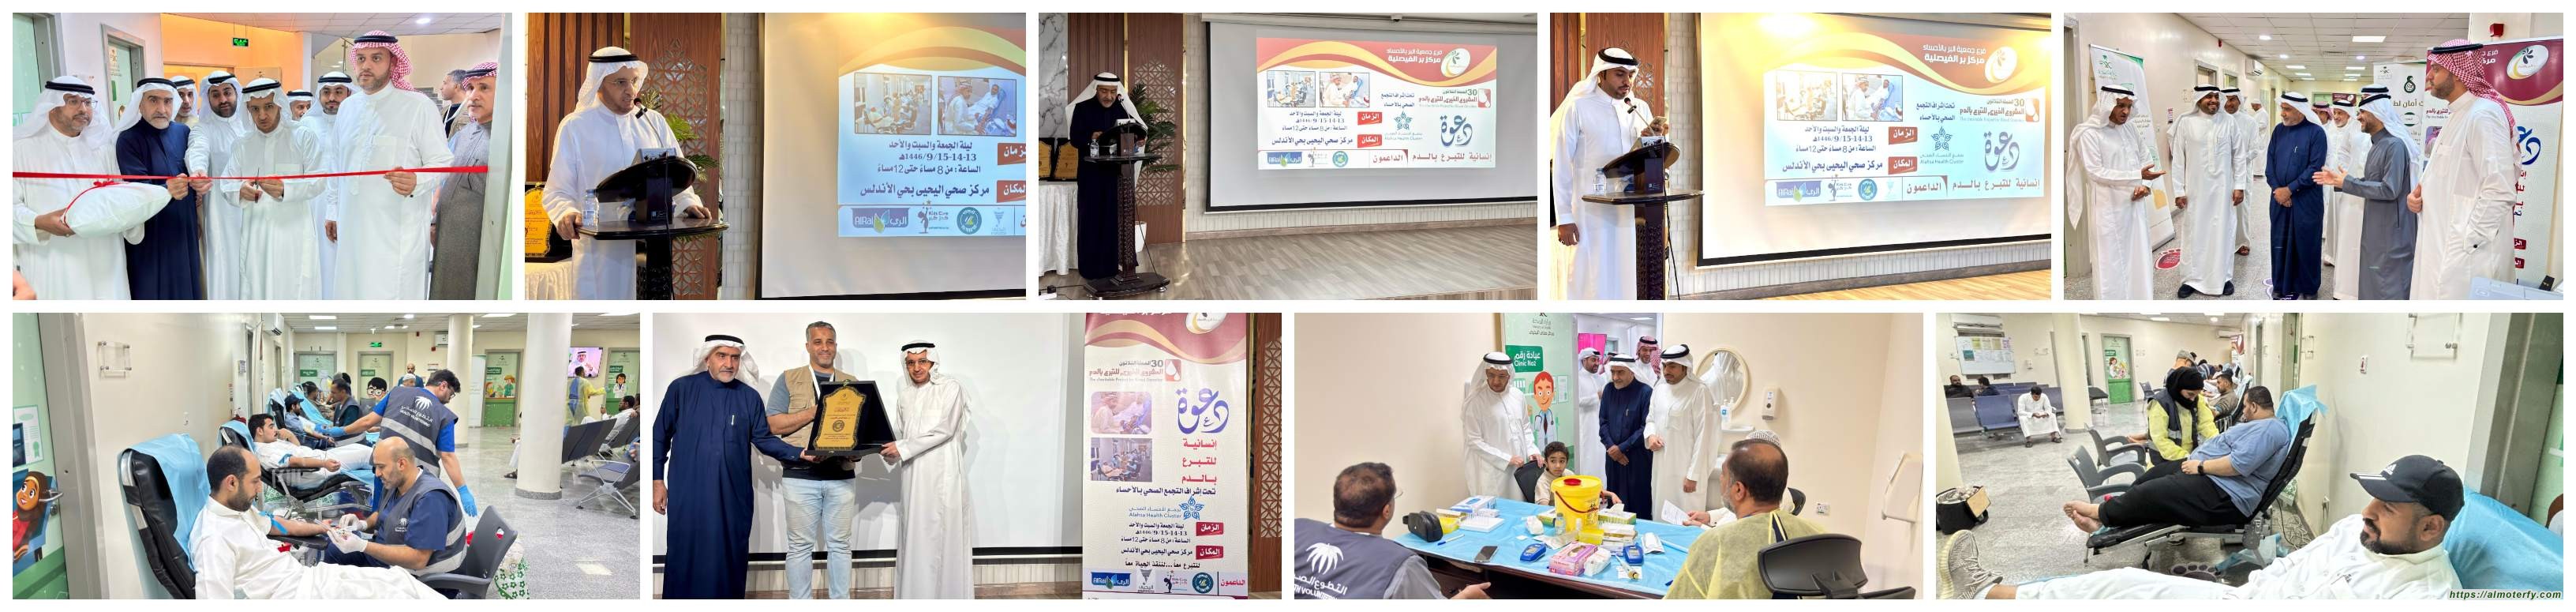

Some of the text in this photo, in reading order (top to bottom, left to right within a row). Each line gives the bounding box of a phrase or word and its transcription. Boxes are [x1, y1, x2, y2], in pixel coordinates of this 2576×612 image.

[1956, 46, 1976, 54] جمعية
[1924, 53, 1985, 65] مركز بر الفيصلية
[1893, 129, 1915, 138] الزمان
[889, 139, 911, 150] والأحد
[912, 140, 935, 150] والسبت
[937, 141, 958, 151] الجمعة
[1983, 131, 2020, 171] دعوة
[1372, 154, 1403, 163] الداعمون
[1441, 152, 1465, 162] للتبرع
[1469, 152, 1492, 163] إنسانية
[1782, 160, 1810, 172] الأندلس
[1811, 163, 1825, 172] بحي
[1849, 161, 1866, 172] صحي
[1866, 160, 1882, 170] مركز
[1893, 158, 1914, 169] المكان
[894, 165, 904, 174] 12
[904, 165, 918, 175] حتى
[937, 165, 943, 175] 8
[945, 167, 953, 175] من
[1906, 182, 1941, 194] الداعمون
[1985, 178, 2011, 190] للتبرع
[2016, 177, 2040, 190] إنسانية
[860, 183, 990, 197] مركز صحي اليحيى بحي الأندلس
[1003, 183, 1026, 195] لمكان
[1515, 351, 1541, 361] عيادة رقم
[1151, 359, 1163, 368] 30
[1104, 368, 1119, 377] للتبرع
[1175, 388, 1229, 434] دعوة
[1183, 438, 1217, 450] إنسانية
[1144, 487, 1163, 497] الصحي
[1163, 486, 1184, 496] التجمع
[1184, 487, 1202, 496] إشراف
[1200, 524, 1219, 532] الزمان
[1200, 547, 1219, 557] المكان
[1220, 578, 1245, 587] الداعمون
[1313, 580, 1348, 595] التطوع
